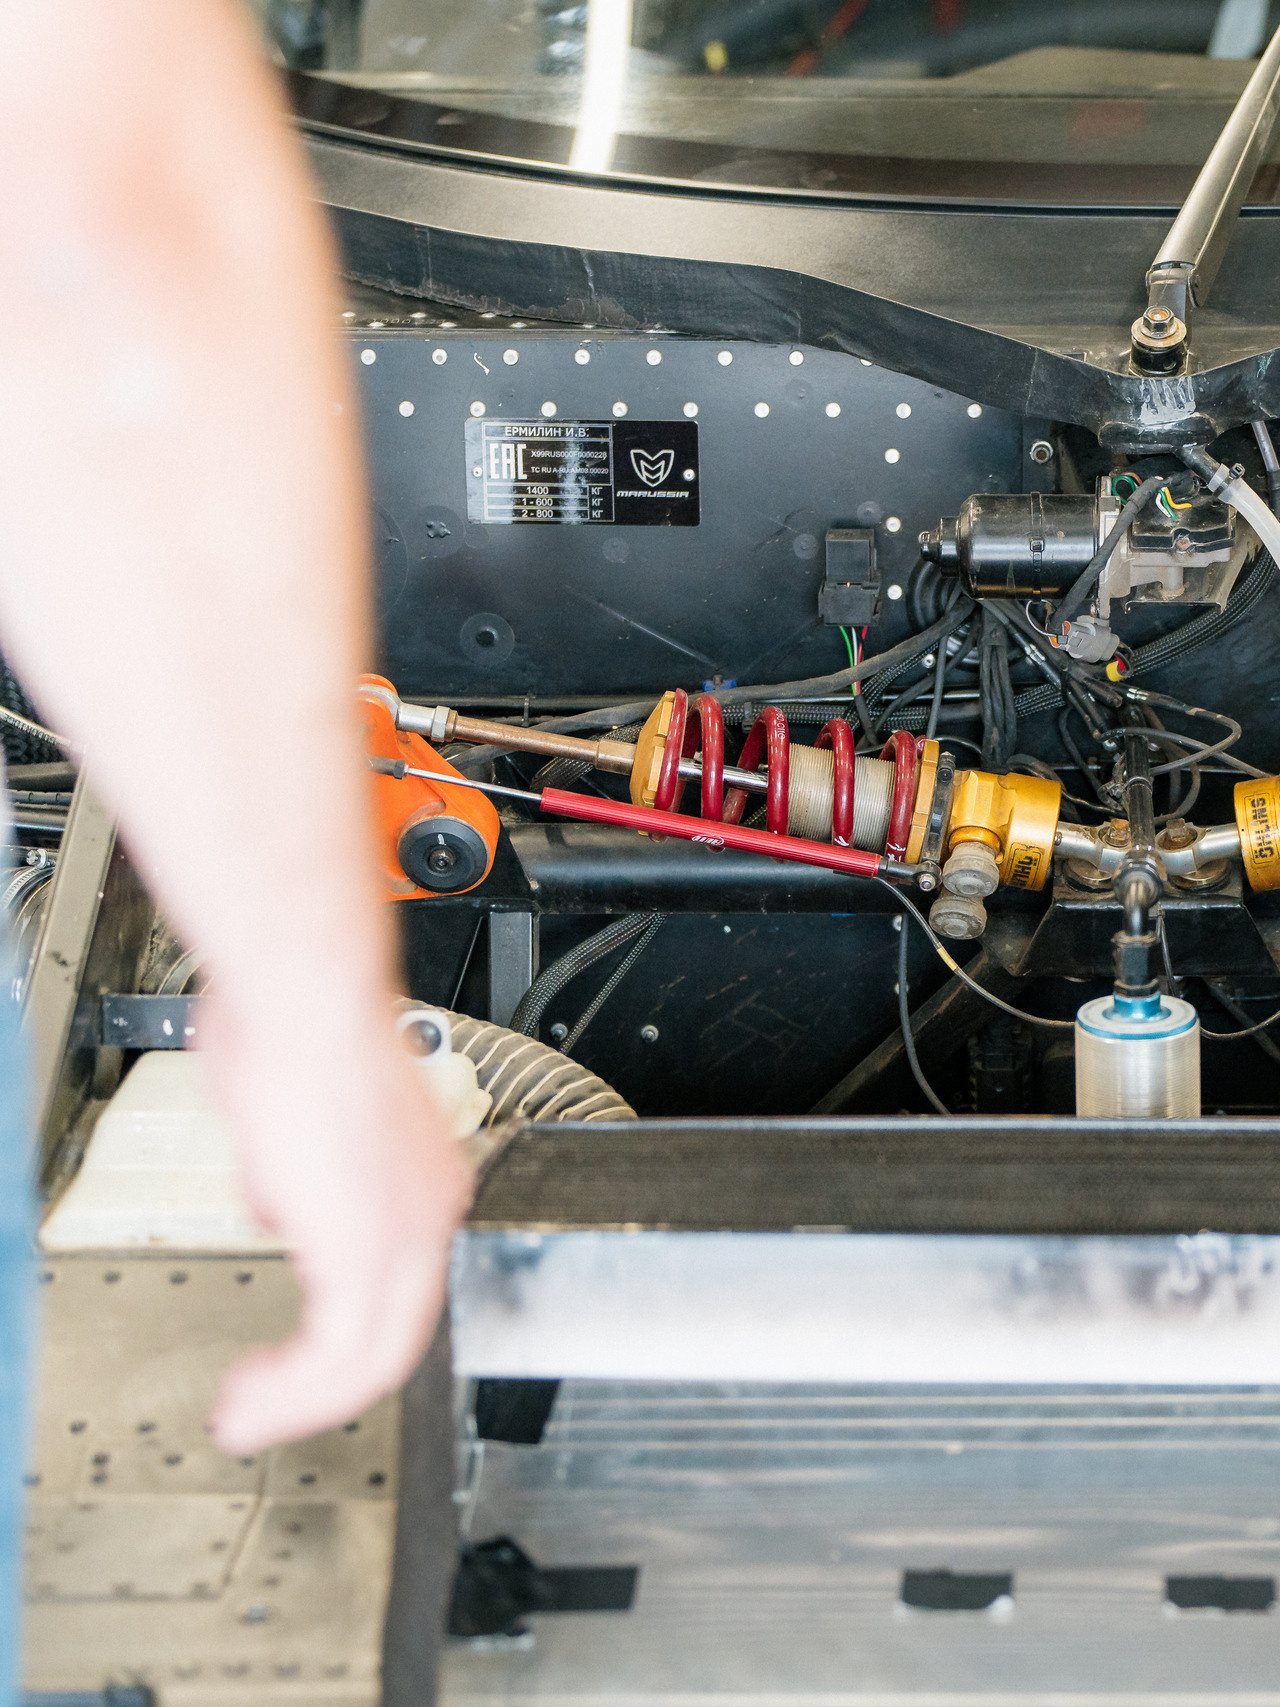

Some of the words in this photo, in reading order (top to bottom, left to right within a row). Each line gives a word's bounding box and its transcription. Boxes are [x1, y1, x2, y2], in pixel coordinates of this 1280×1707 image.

[504, 426, 562, 437] ЕРМИЛИН
[489, 443, 528, 480] EAC
[526, 486, 549, 495] 1400
[616, 490, 690, 498] MARUSSIA
[535, 497, 553, 506] 600
[536, 509, 554, 518] 800
[1250, 797, 1275, 859] ÖHLINS
